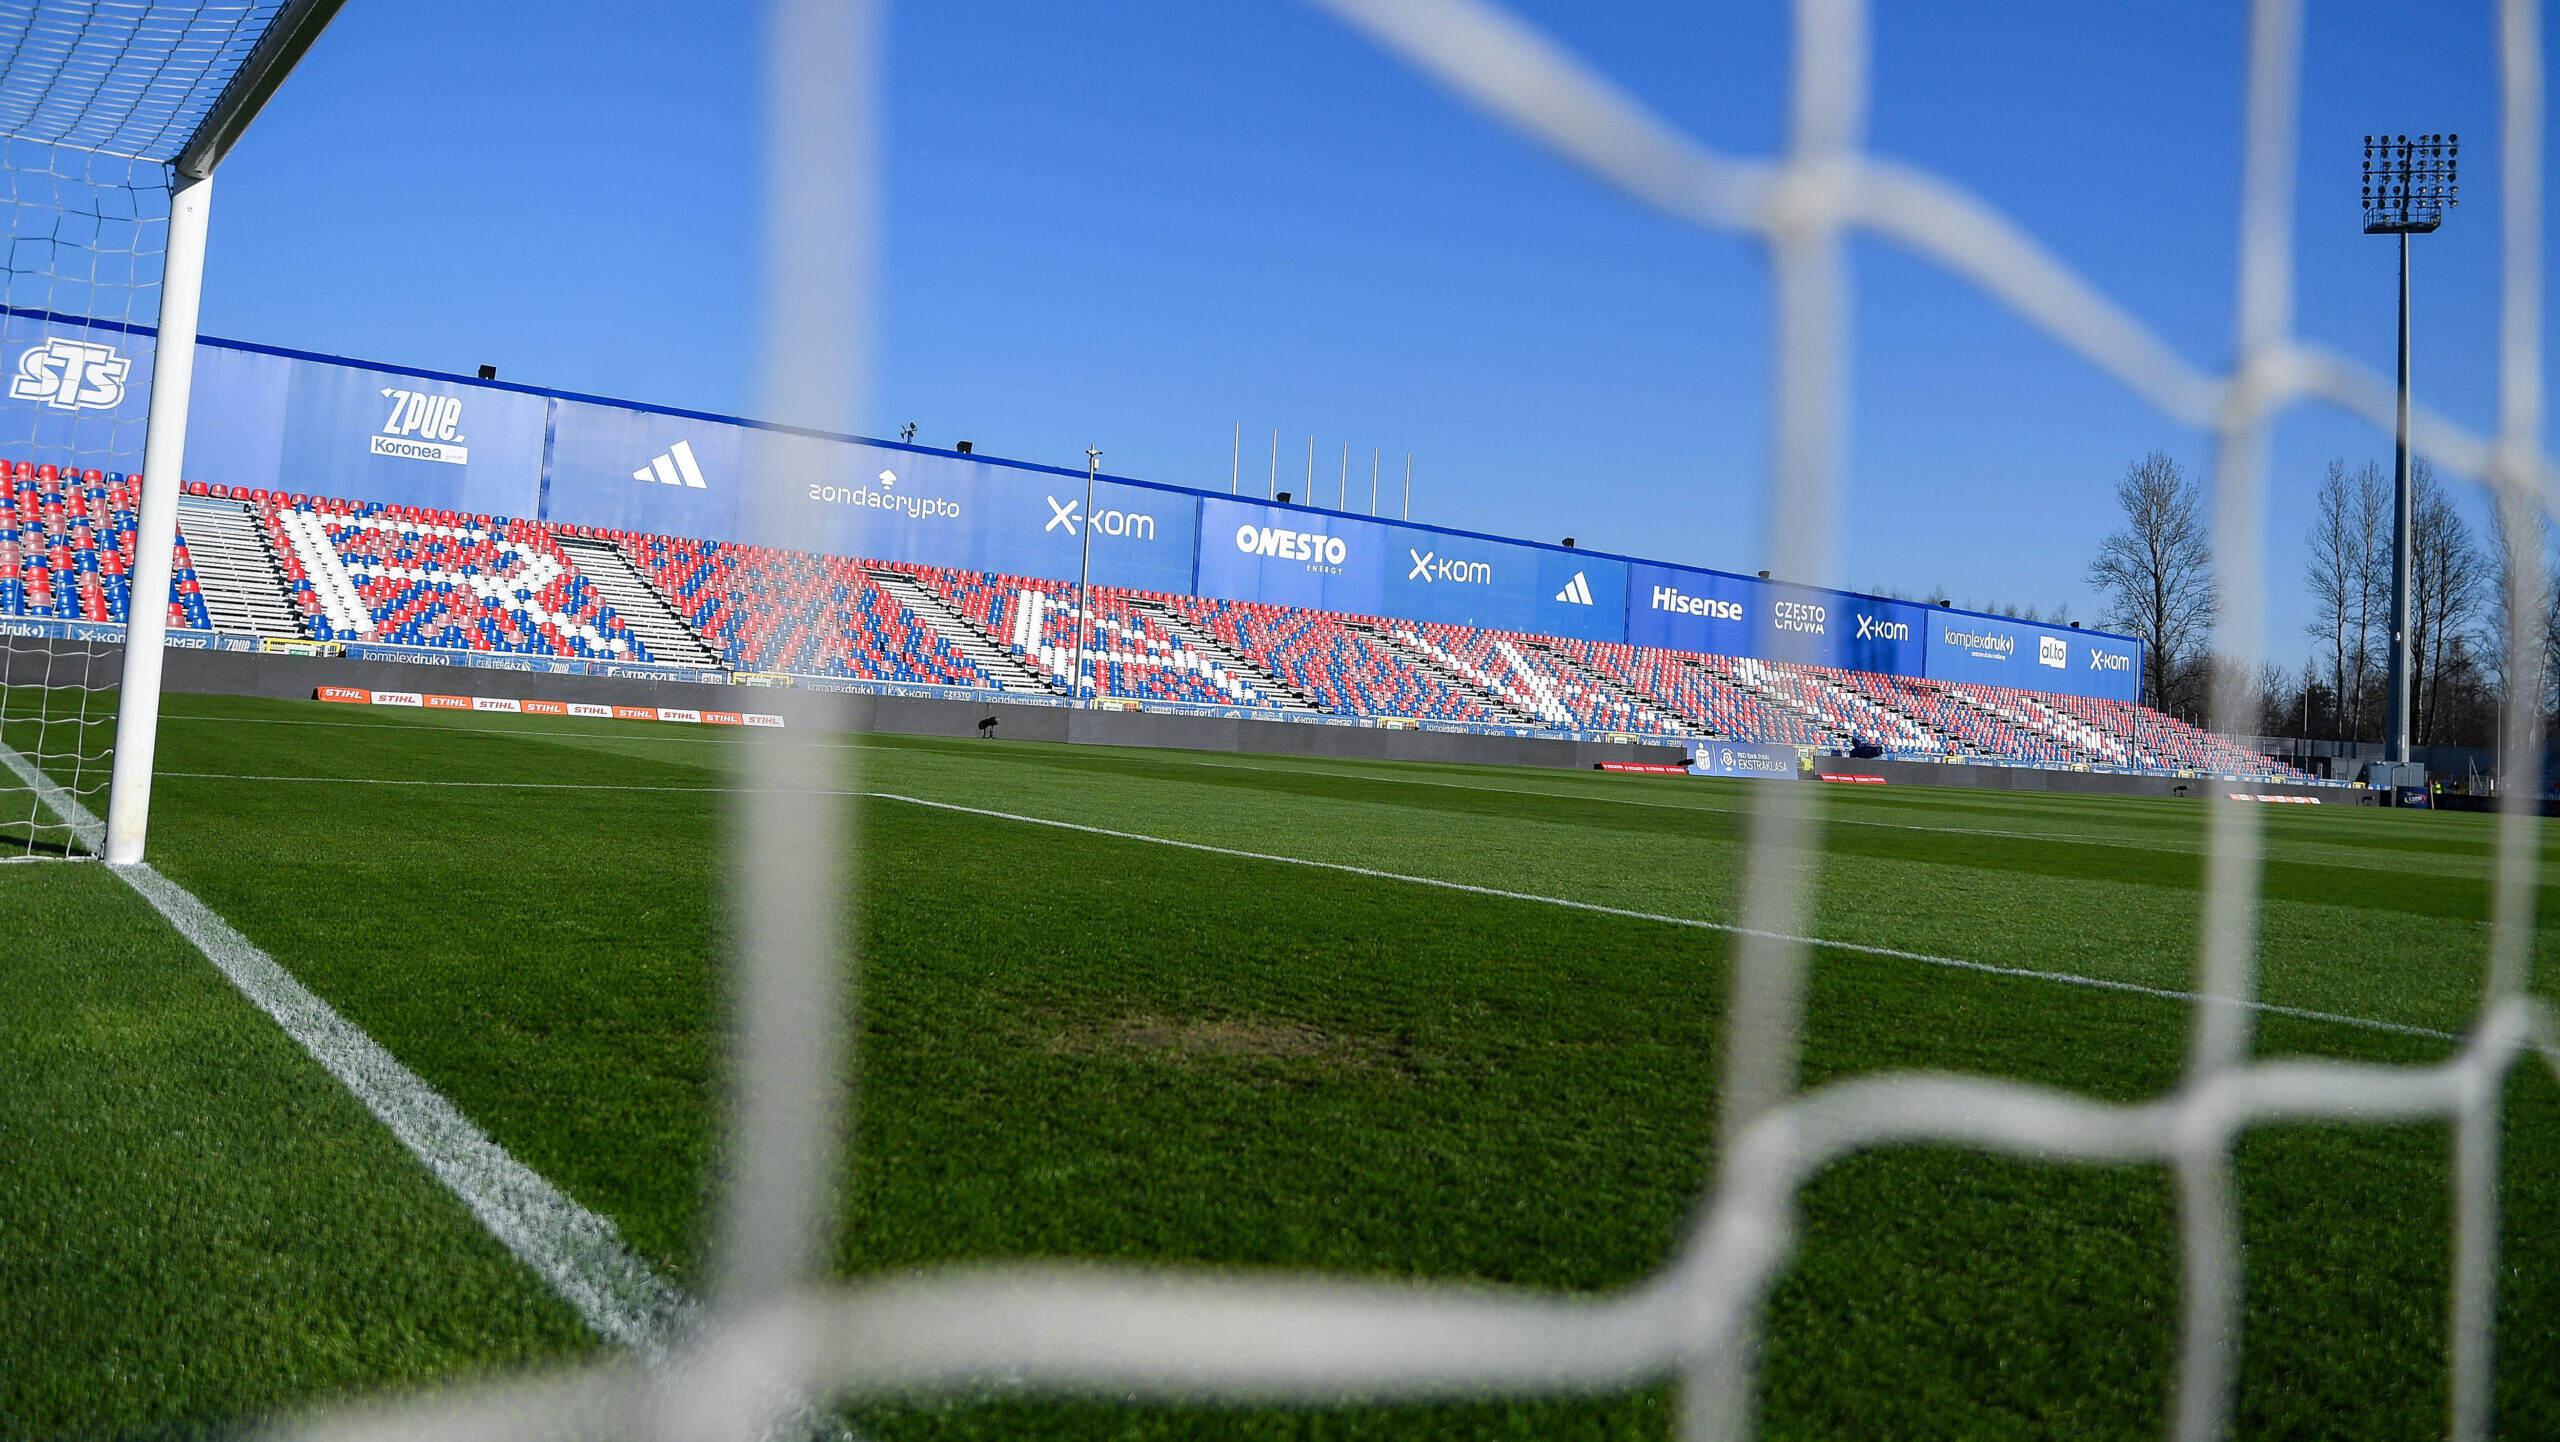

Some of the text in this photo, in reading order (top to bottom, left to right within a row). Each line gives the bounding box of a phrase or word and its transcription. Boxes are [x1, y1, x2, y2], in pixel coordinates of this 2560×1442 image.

[9, 336, 132, 411] STS
[375, 438, 442, 459] Koronea
[808, 483, 961, 520] zondacrypto
[1236, 524, 1347, 565] ONESTO
[1306, 564, 1343, 575] ENERGY
[1652, 585, 1743, 621] Hisense
[1944, 625, 2006, 652] komplexdruk
[2041, 643, 2065, 661] al.to
[362, 650, 439, 666] komplexdruk
[475, 659, 522, 671] CENTERGAZ
[325, 688, 363, 699] STIHL
[378, 694, 416, 704] STIHL
[429, 697, 467, 707] STIHL
[479, 700, 515, 710] STIHL
[527, 703, 562, 713] STIHL
[574, 706, 608, 715] STIHL
[618, 709, 653, 719] STIHL
[663, 711, 696, 720] STIHL
[706, 714, 738, 722] STIHL
[748, 715, 780, 725] STIHL
[1738, 759, 1788, 772] EKSTRAKLASA
